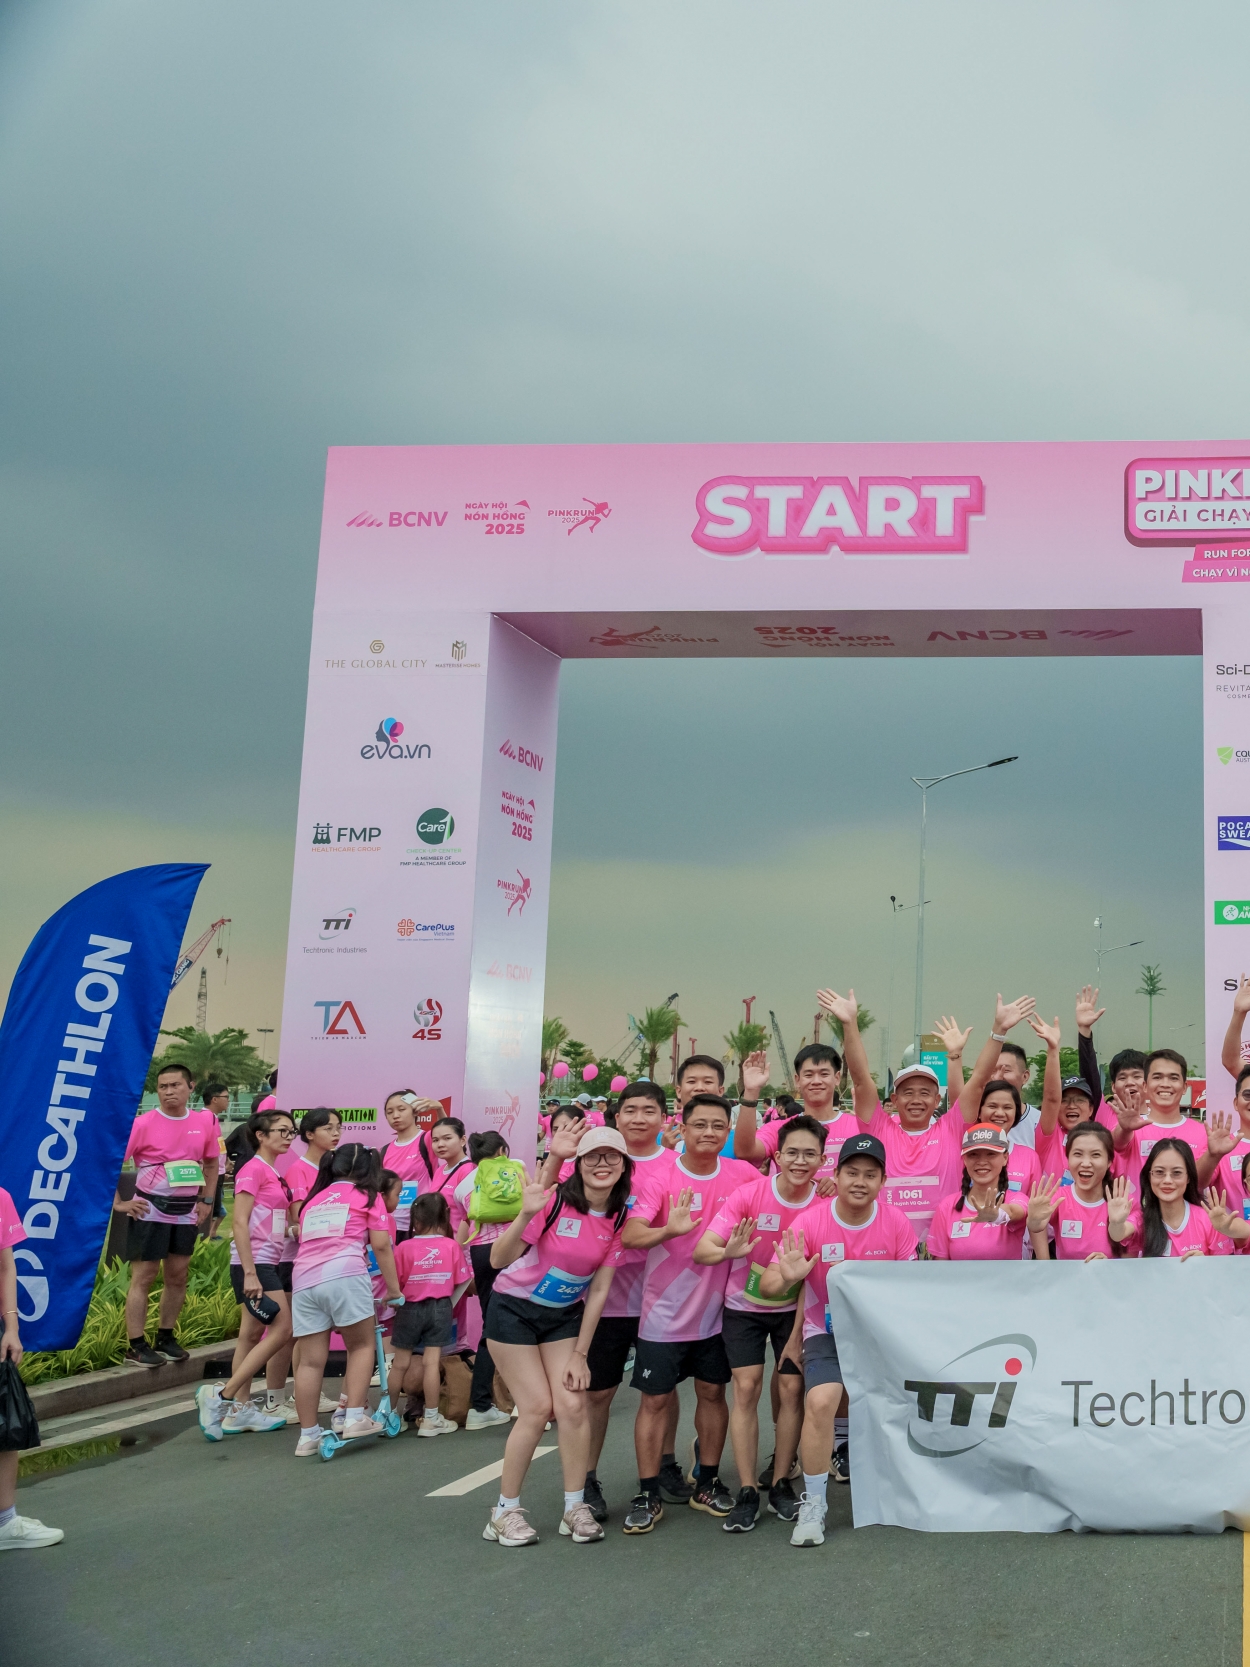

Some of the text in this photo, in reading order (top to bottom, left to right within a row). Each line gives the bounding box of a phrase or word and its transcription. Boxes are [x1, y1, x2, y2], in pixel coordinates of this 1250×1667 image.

[465, 501, 508, 510] NGÀY HỘI
[702, 482, 972, 540] START
[388, 511, 448, 527] BCNV
[464, 510, 526, 521] NÓN HỒNG
[547, 509, 595, 517] PINKRUN
[1143, 505, 1188, 523] GIẢI
[485, 523, 525, 535] 2025
[1204, 550, 1228, 559] RUN
[1192, 568, 1224, 580] CHẠY
[1226, 566, 1238, 577] VÌ
[753, 626, 840, 635] 2025
[926, 630, 1048, 642] BCNV
[325, 659, 427, 669] THE GLOBAL CITY
[360, 744, 431, 760] eva.vn
[518, 746, 544, 771] BCNV
[337, 827, 382, 843] FMP
[511, 821, 532, 841] 2025
[497, 879, 523, 894] PINKRUN
[415, 923, 455, 931] CarePlus
[303, 946, 368, 954] Techtronic Industries
[506, 964, 532, 982] BCNV
[412, 1028, 442, 1041] 4S
[23, 933, 133, 1239] DECATHLON
[485, 1105, 512, 1116] PINKRUN
[898, 1189, 923, 1199] 1061
[538, 1280, 550, 1294] 5KM
[747, 1273, 757, 1290] 10KM
[556, 1284, 583, 1293] 2420
